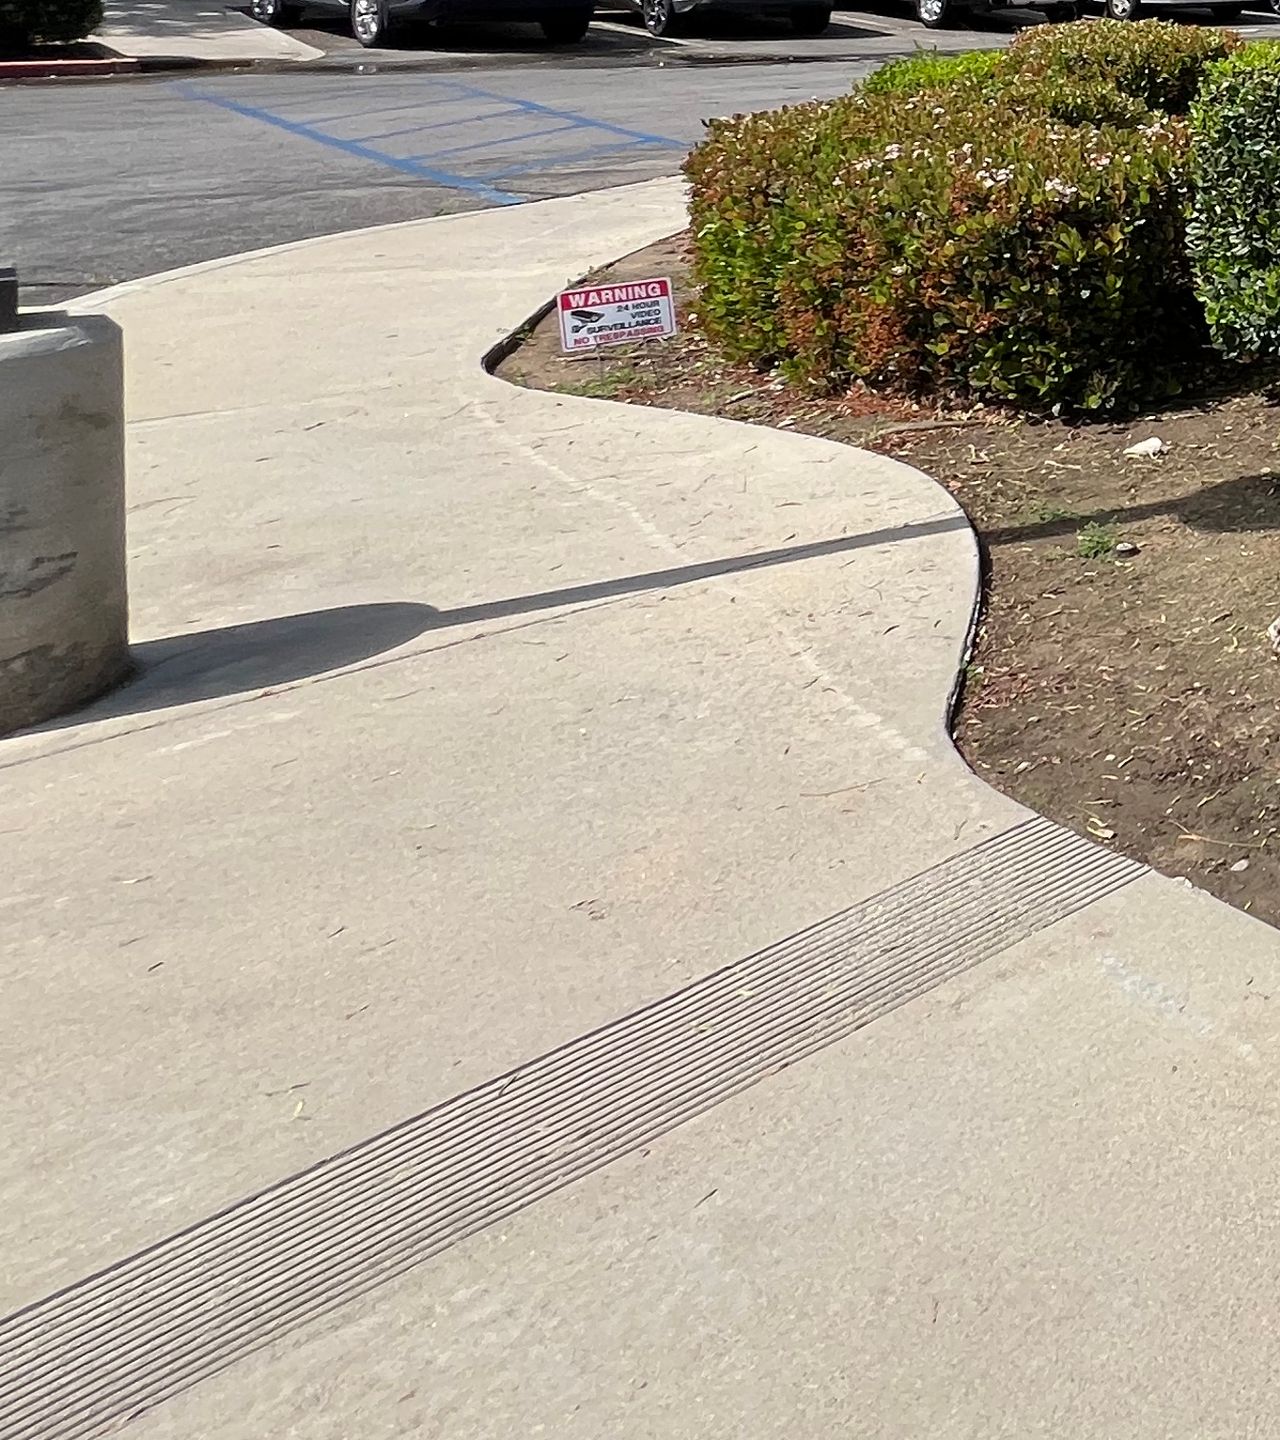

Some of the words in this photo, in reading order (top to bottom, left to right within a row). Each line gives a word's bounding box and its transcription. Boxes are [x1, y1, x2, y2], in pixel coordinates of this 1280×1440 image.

[567, 283, 661, 308] WARNING
[616, 304, 629, 312] 24
[632, 300, 660, 310] HOUR
[630, 309, 661, 319] VIDEO
[587, 317, 662, 335] SURVEILLANCE
[574, 337, 589, 347] NO
